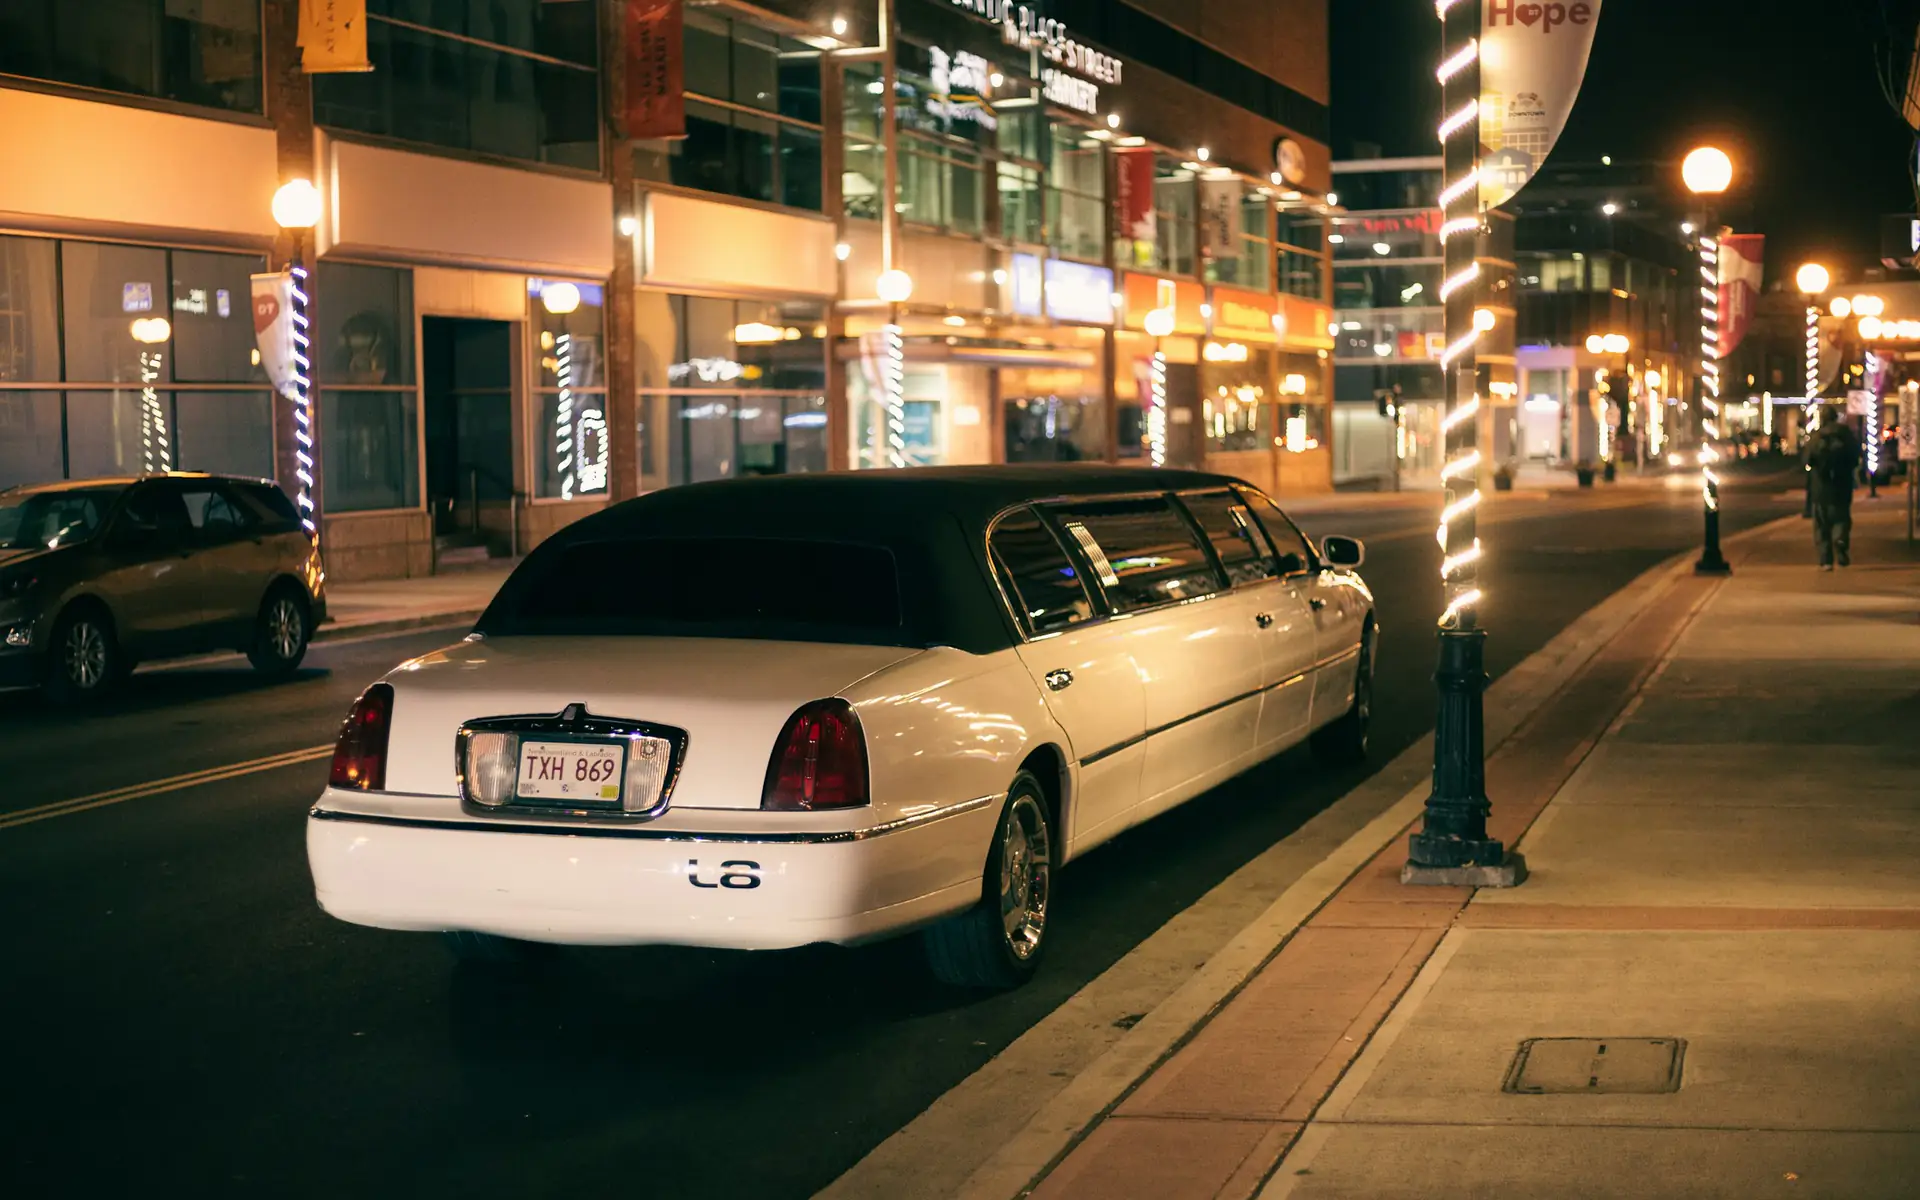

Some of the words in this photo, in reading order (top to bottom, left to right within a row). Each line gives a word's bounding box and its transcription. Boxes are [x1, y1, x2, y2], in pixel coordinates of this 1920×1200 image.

[257, 302, 275, 315] DT
[585, 750, 615, 758] Labrador
[526, 756, 565, 781] TXH
[575, 758, 615, 782] 869
